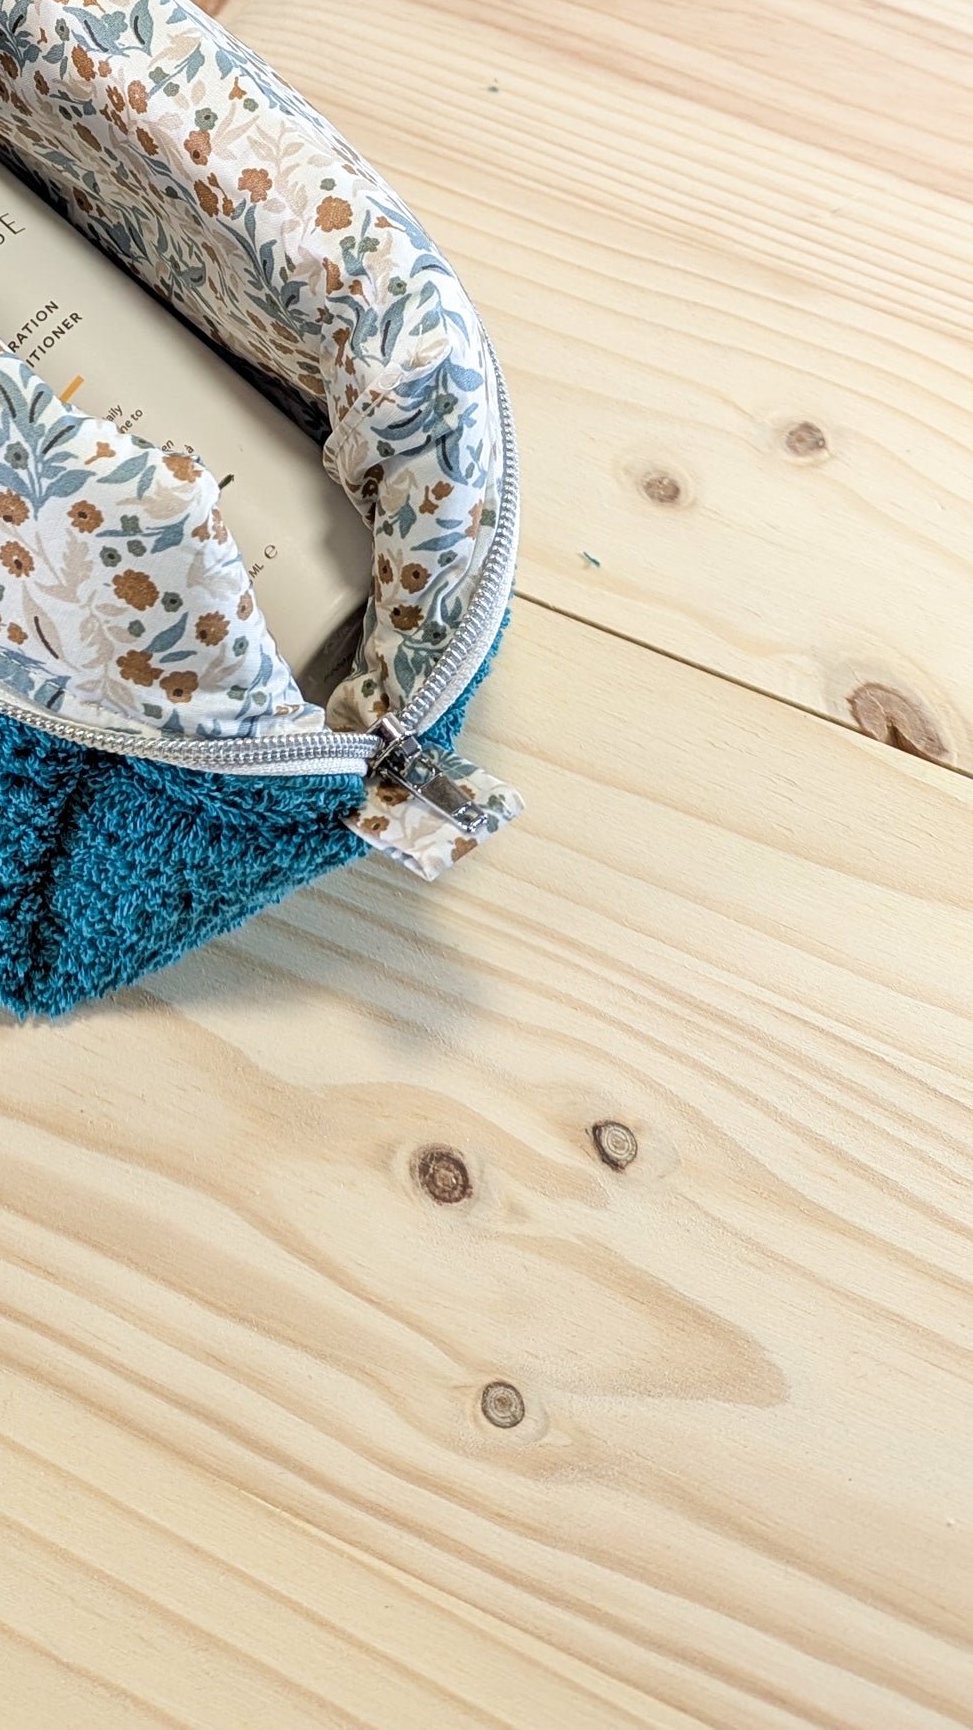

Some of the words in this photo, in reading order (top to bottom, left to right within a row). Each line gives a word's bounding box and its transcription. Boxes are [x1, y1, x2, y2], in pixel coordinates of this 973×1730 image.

[7, 300, 59, 353] RATION
[25, 312, 83, 368] ITIONER
[131, 408, 144, 421] to
[249, 562, 265, 579] ML
